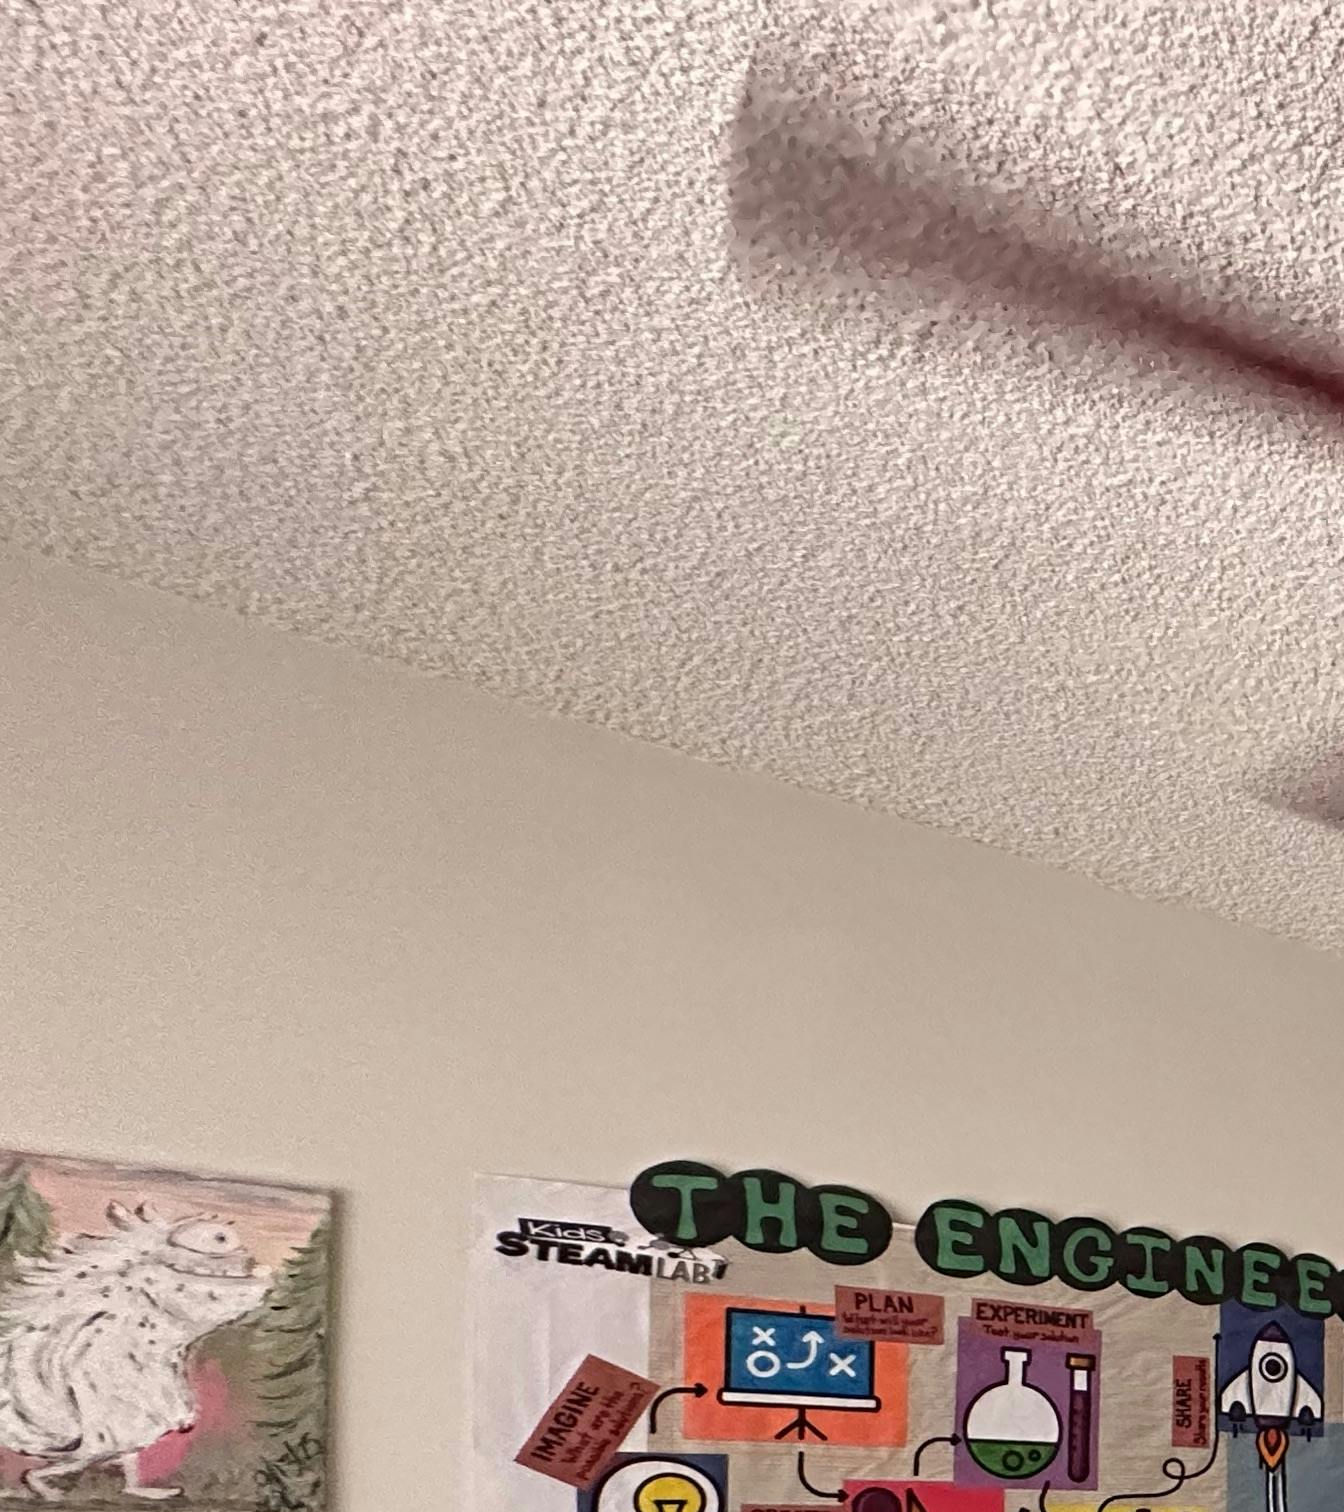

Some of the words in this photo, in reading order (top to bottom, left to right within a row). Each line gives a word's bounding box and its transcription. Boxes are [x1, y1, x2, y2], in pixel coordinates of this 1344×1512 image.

[528, 1222, 606, 1243] Kids
[652, 1173, 870, 1256] THE
[854, 1292, 914, 1313] PLAN
[976, 1302, 1089, 1329] EXPERIMENT
[530, 1381, 600, 1462] IMAGINE
[1175, 1379, 1192, 1429] SHARE
